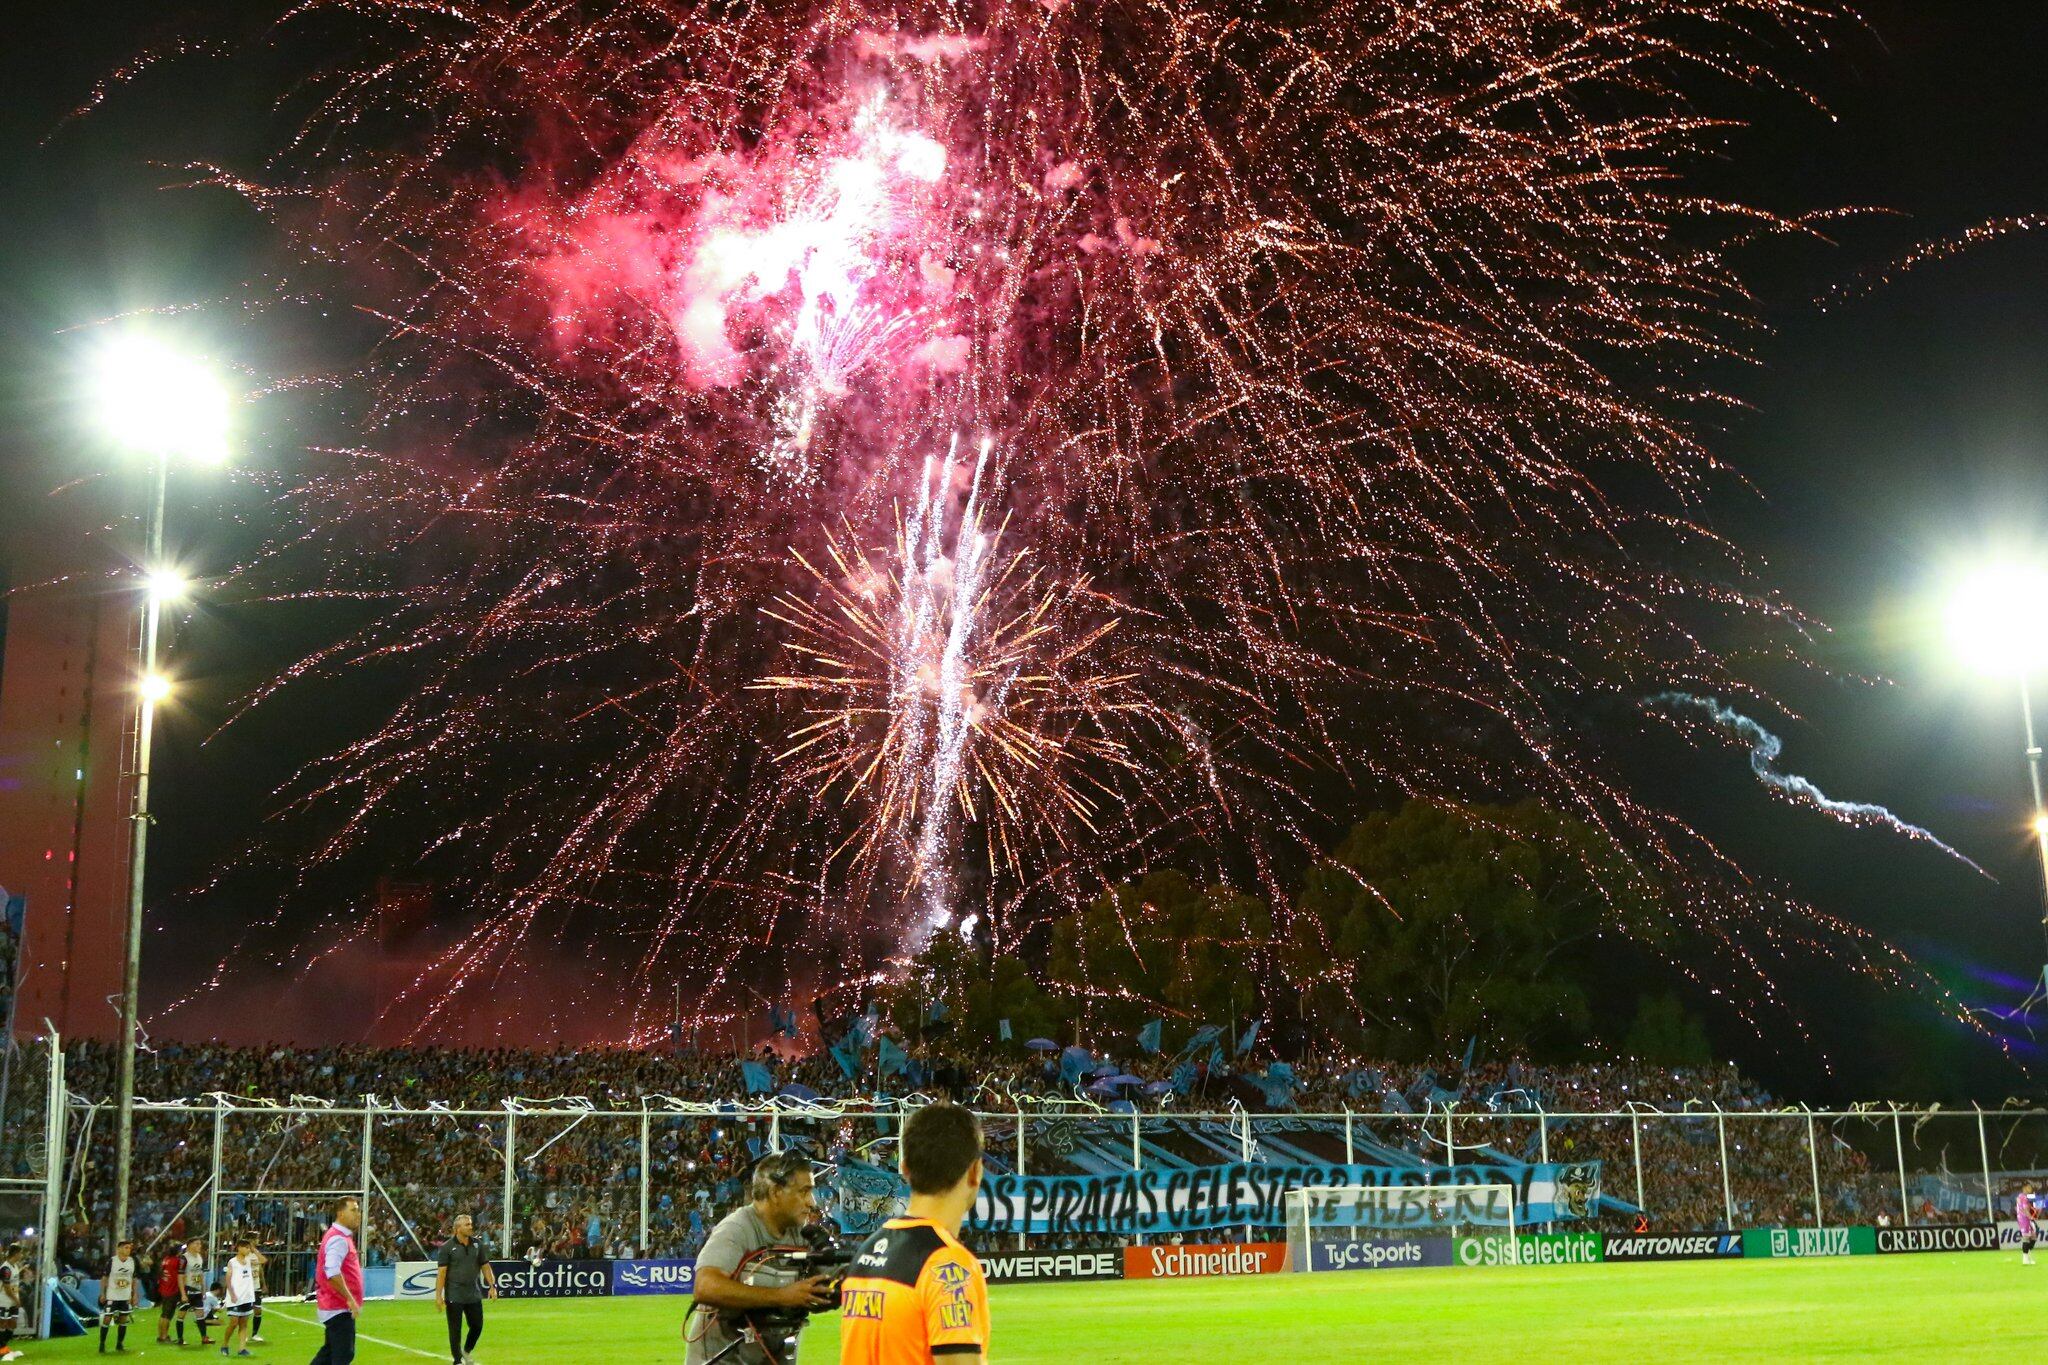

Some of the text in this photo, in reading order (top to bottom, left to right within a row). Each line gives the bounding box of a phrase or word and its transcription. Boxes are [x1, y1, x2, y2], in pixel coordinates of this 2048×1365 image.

[969, 1175, 1016, 1231] OS
[1024, 1171, 1158, 1233] PIRATAS
[1354, 1167, 1533, 1224] ALBERDI
[1484, 1235, 1597, 1265] Sistelectric
[1605, 1236, 1716, 1257] KARTONSEC
[1792, 1228, 1850, 1256] JELUZ
[1877, 1227, 1996, 1251] CREDICOOP
[980, 1253, 1114, 1278] OWERADE
[1151, 1245, 1268, 1277] Schneider
[1324, 1242, 1422, 1269] TyC Sports
[650, 1265, 692, 1283] RUS
